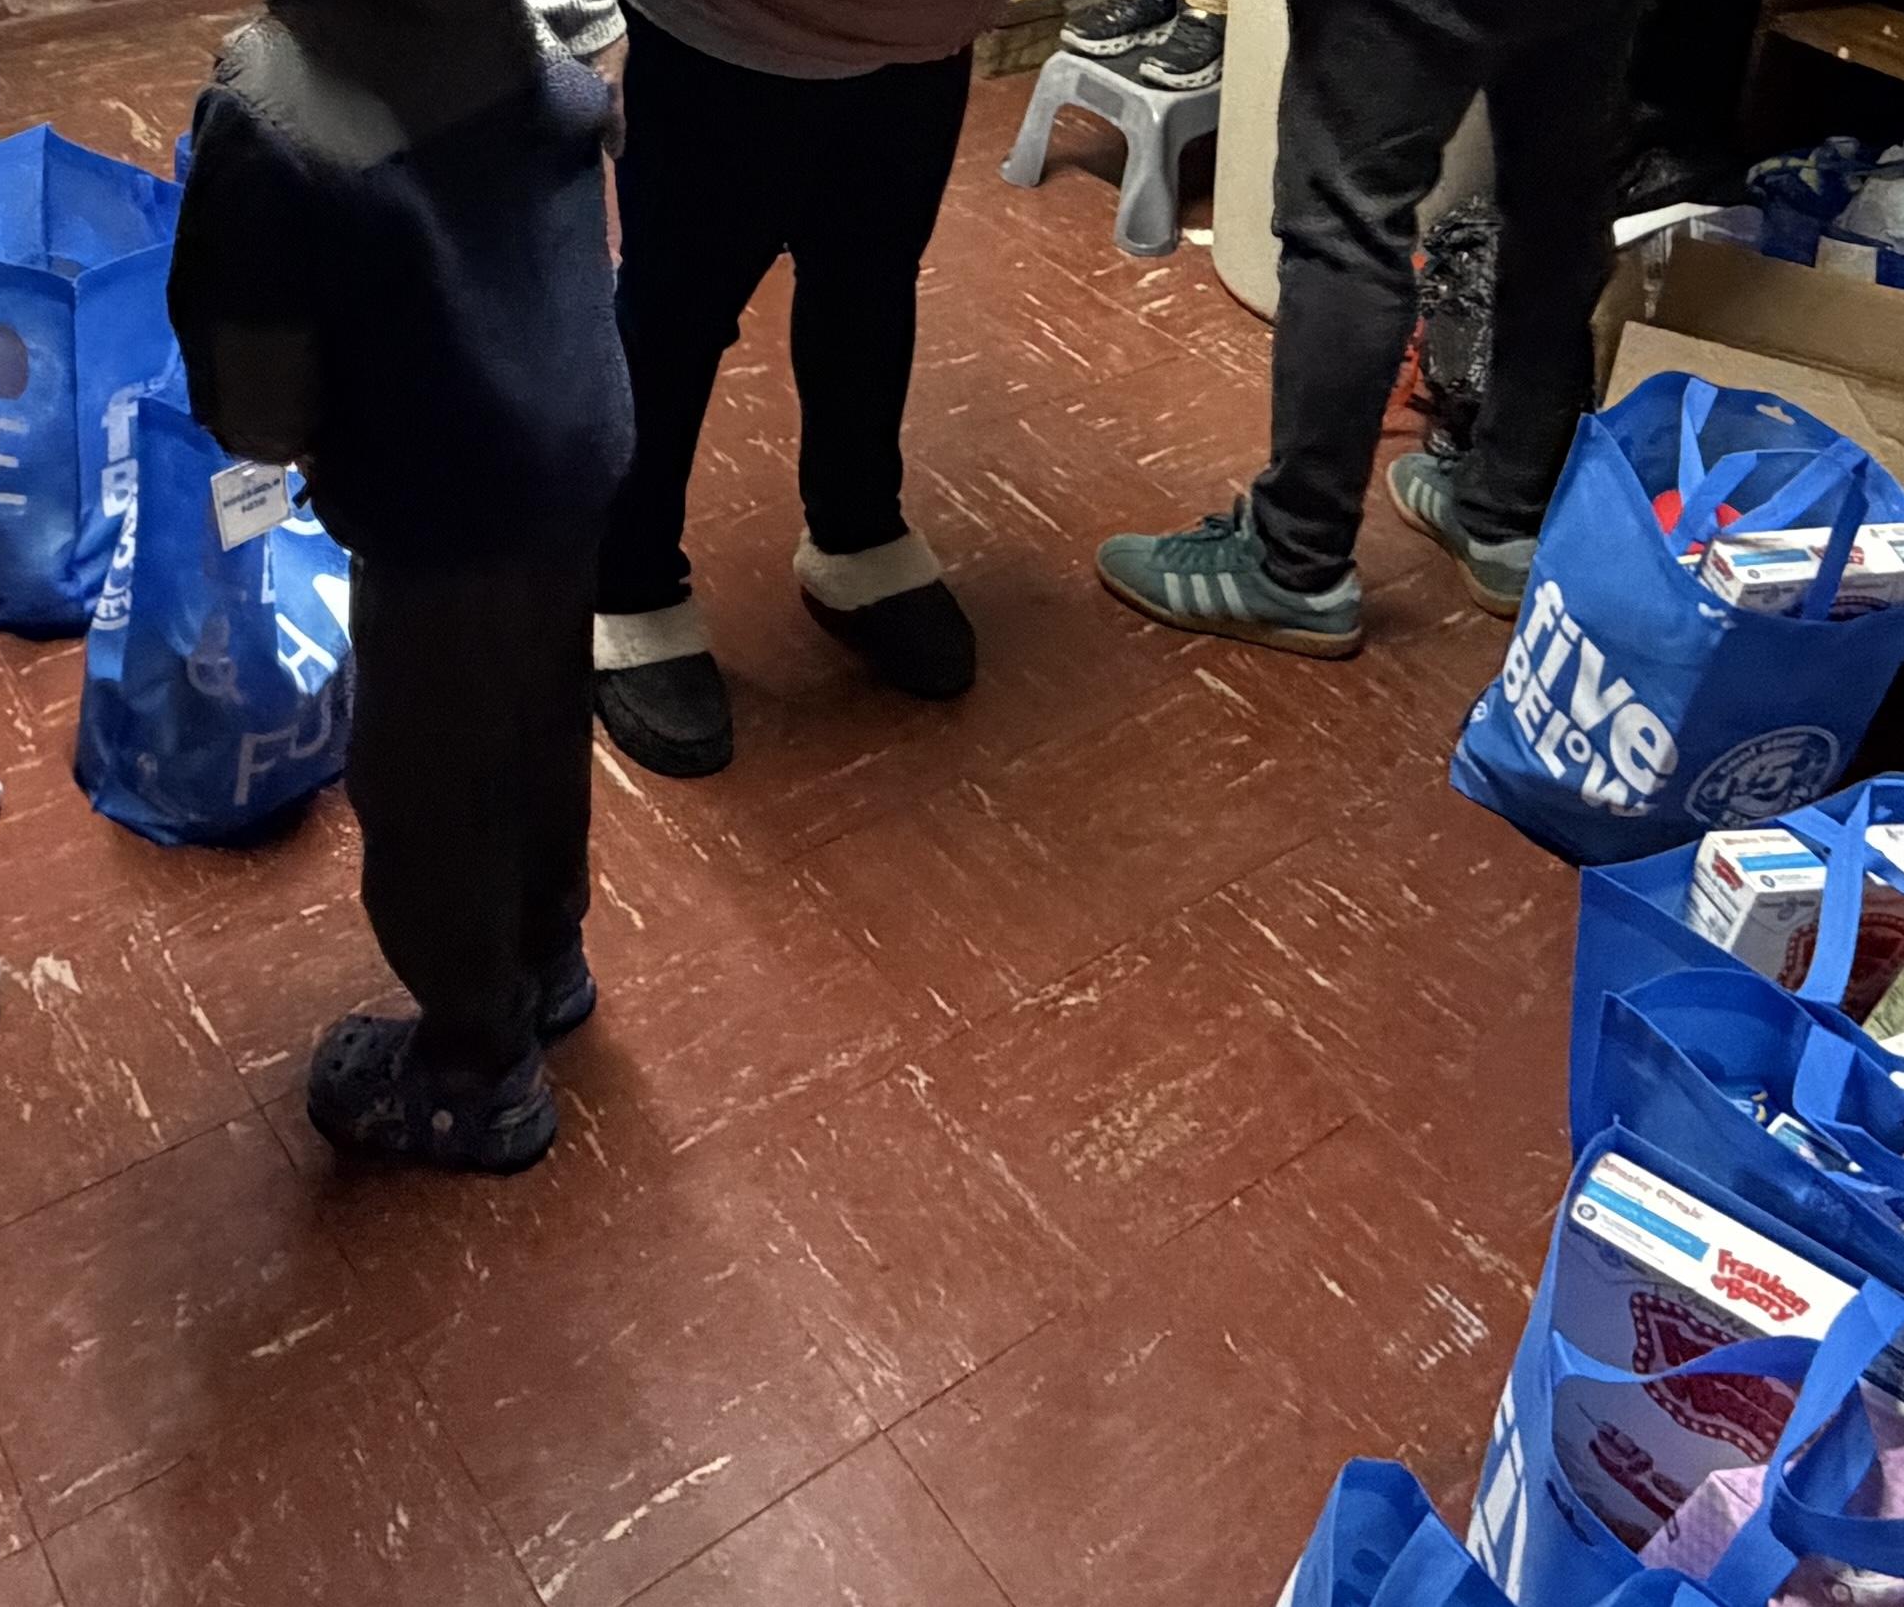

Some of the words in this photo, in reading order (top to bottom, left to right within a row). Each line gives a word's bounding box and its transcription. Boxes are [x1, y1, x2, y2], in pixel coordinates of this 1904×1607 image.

[1502, 634, 1658, 818] BELOW
[1717, 1247, 1811, 1316] Franken
[1725, 1276, 1796, 1323] Berry
